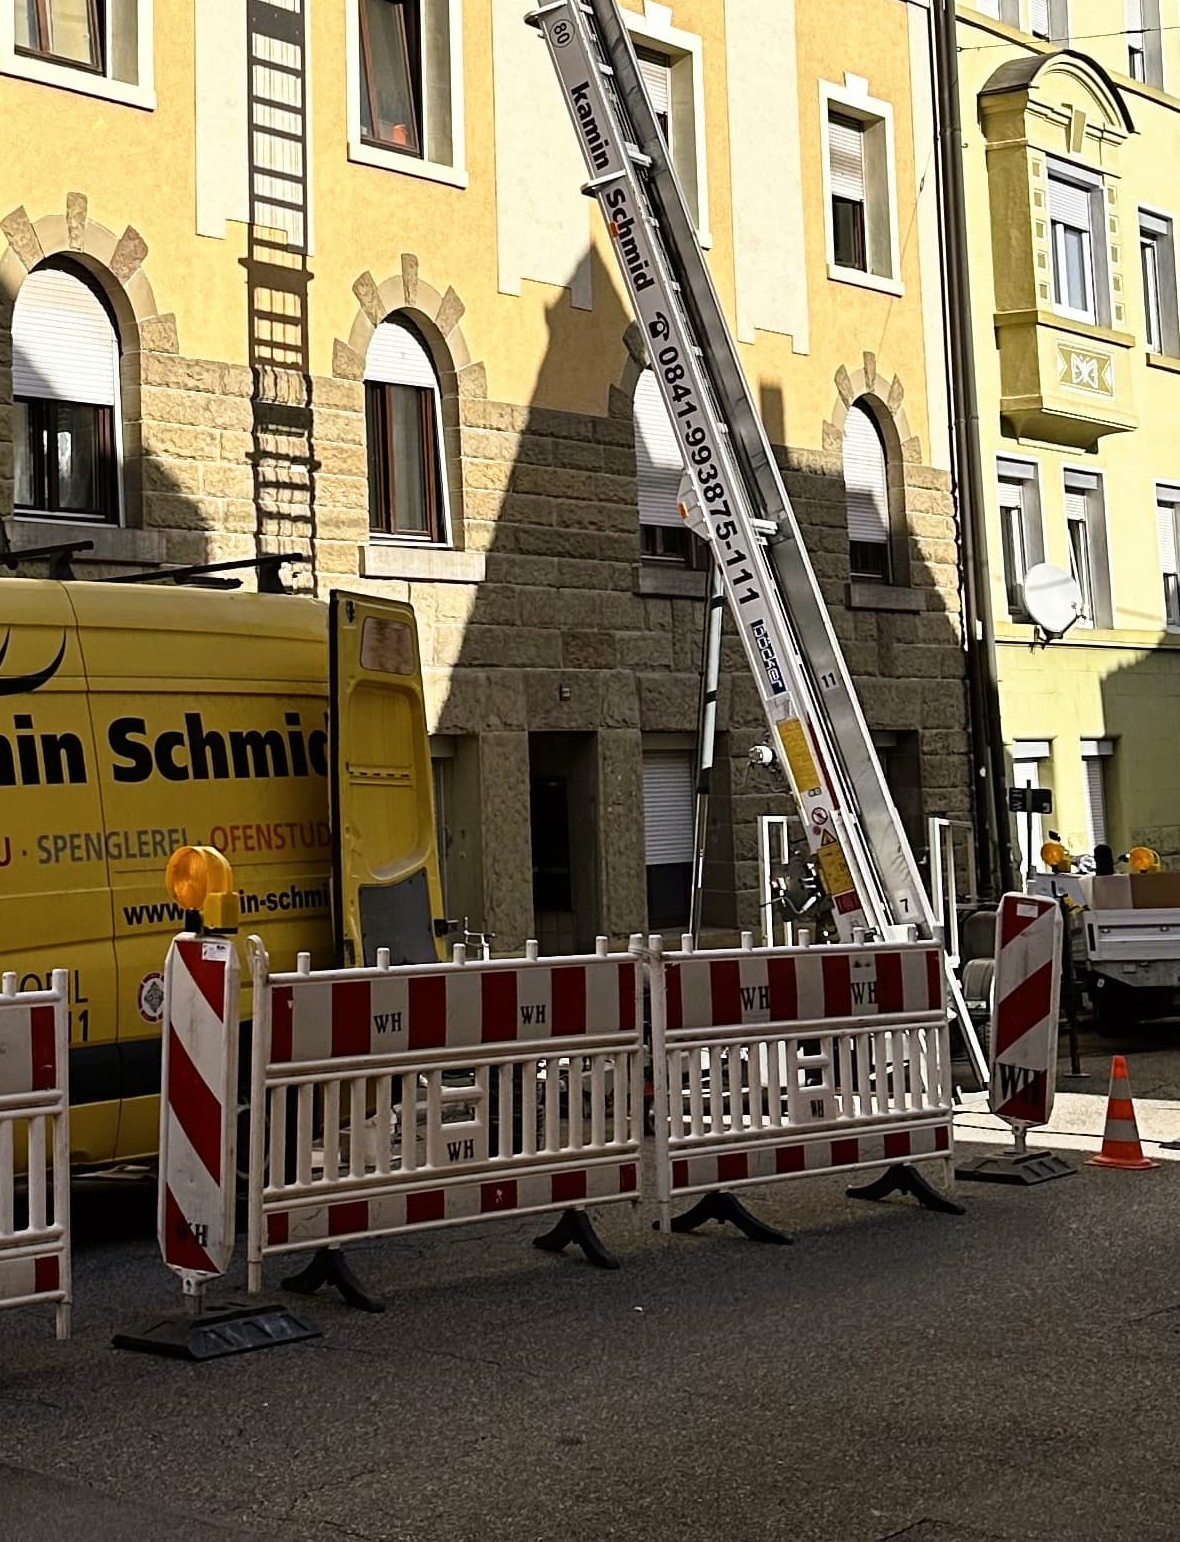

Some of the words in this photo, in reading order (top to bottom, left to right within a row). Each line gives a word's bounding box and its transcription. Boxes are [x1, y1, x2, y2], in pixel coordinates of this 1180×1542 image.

[553, 22, 571, 45] 80
[570, 81, 610, 171] kamin
[606, 187, 655, 293] Schmid
[658, 345, 760, 612] 0841-993875-111
[209, 821, 332, 854] OFENSTUD
[740, 985, 770, 1010] WH
[374, 1012, 403, 1034] WH
[520, 1004, 547, 1025] WH
[446, 1138, 475, 1162] WH
